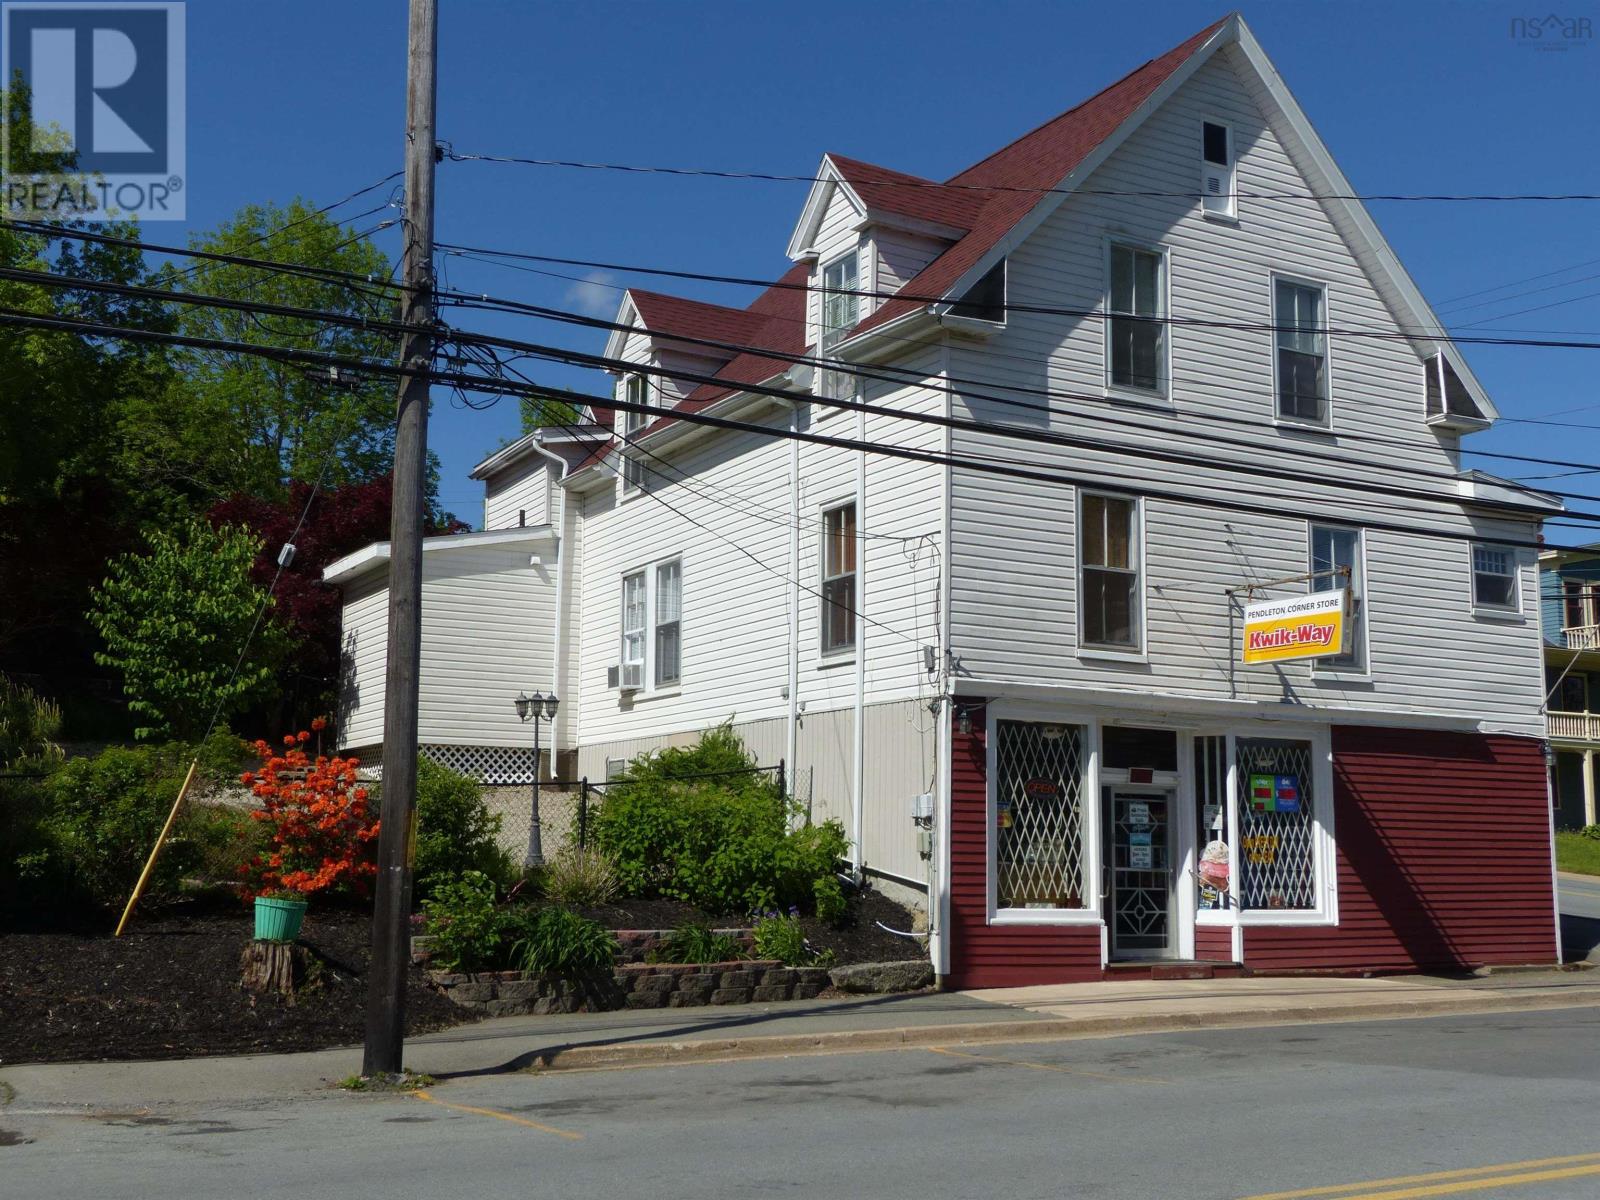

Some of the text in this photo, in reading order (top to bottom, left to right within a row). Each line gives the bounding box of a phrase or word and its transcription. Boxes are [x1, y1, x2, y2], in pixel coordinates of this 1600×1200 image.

[1247, 598, 1339, 619] PENDLETON CORNER STORE
[1248, 623, 1335, 650] Kwik-Way
[1027, 782, 1057, 794] OPEN
